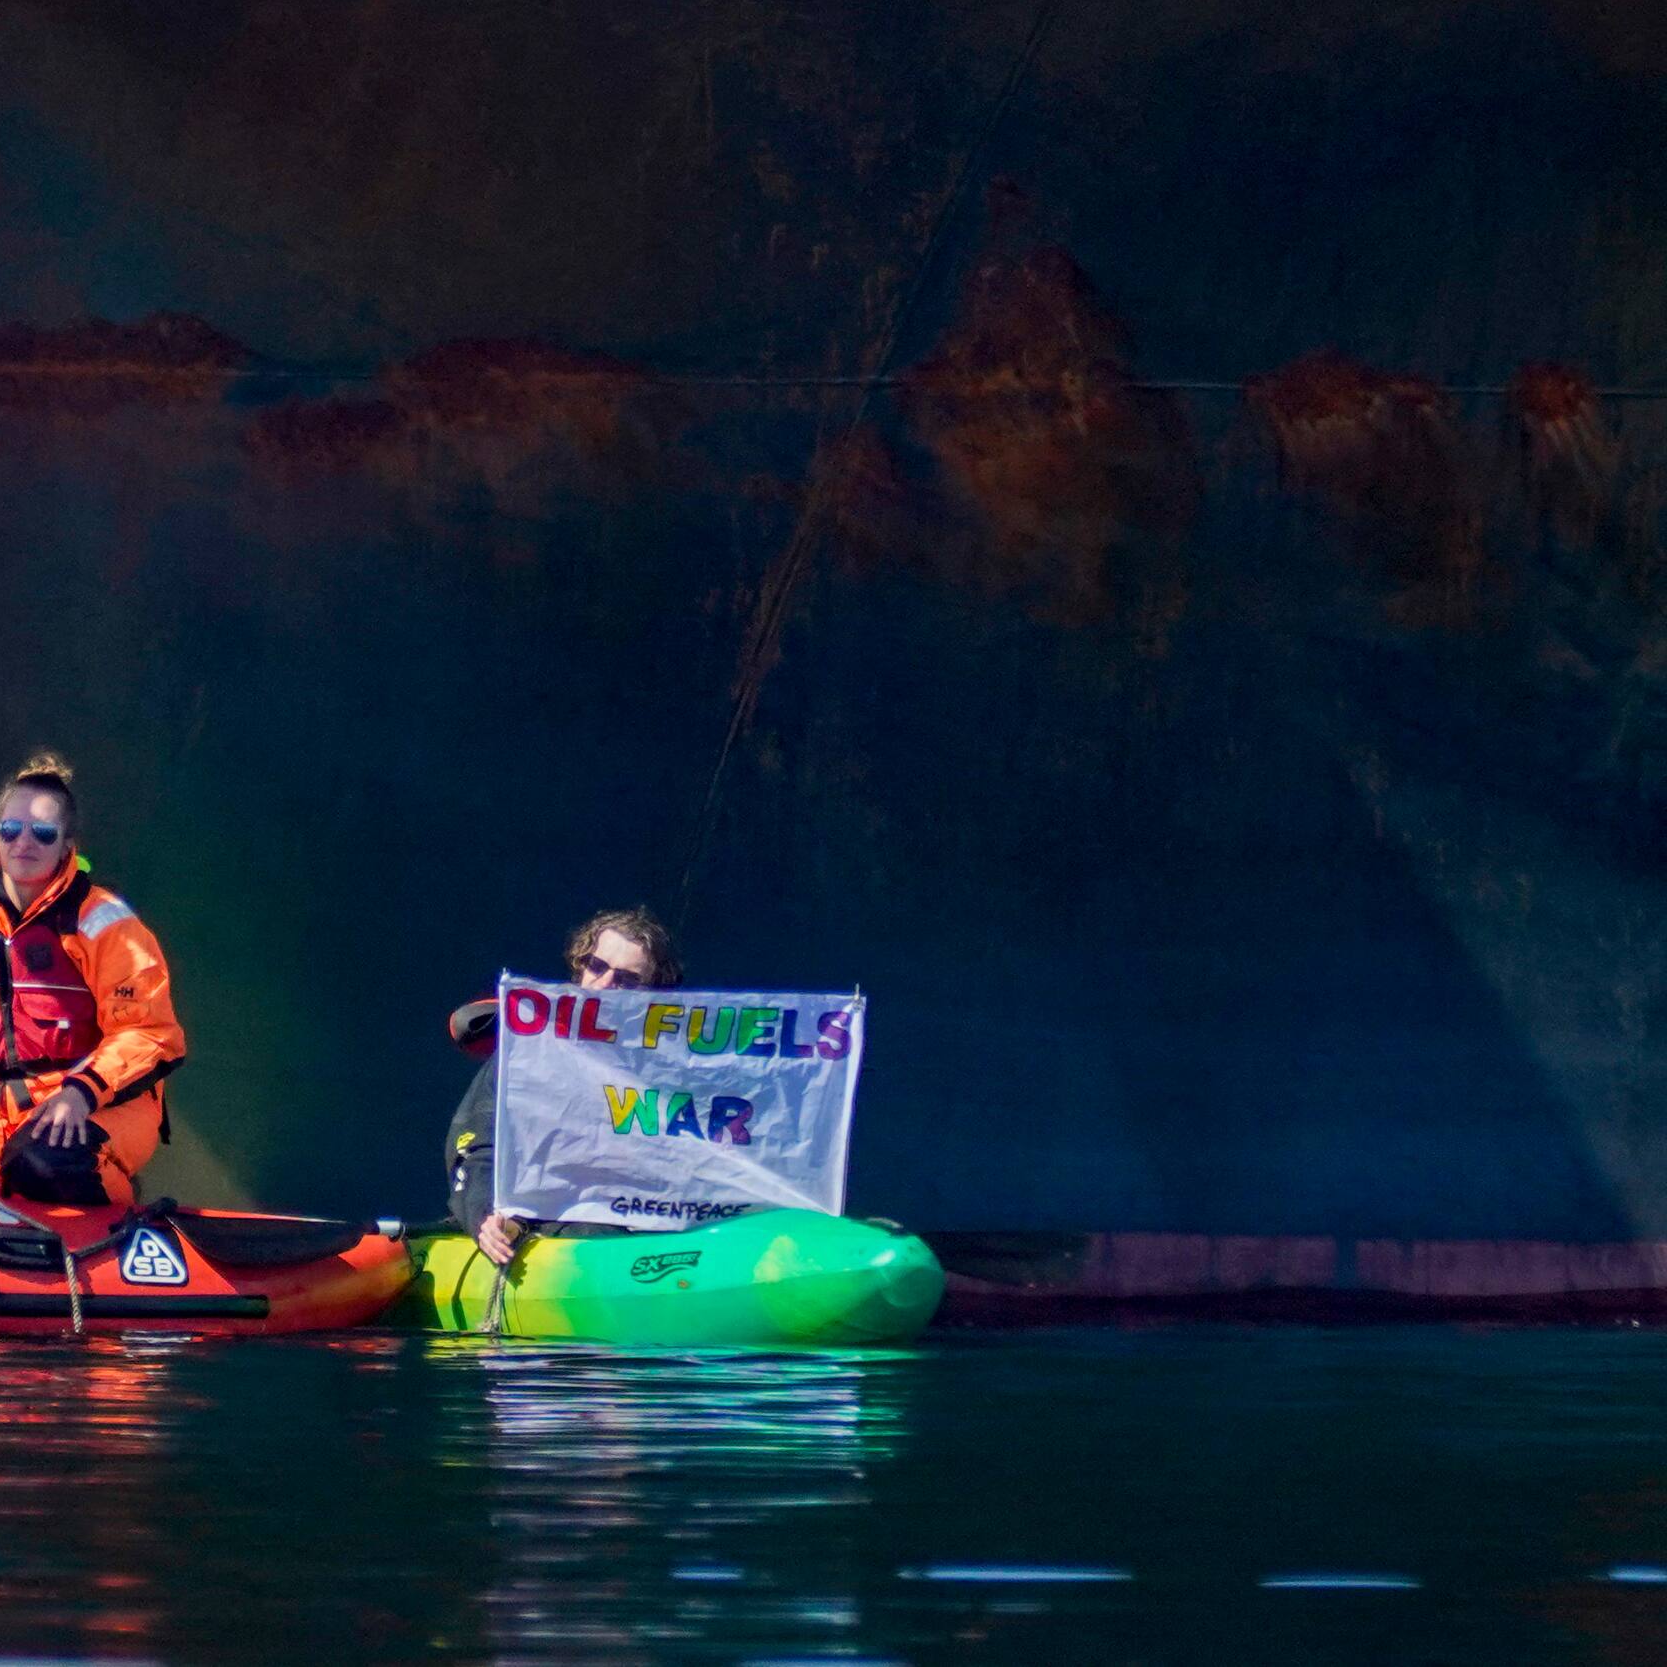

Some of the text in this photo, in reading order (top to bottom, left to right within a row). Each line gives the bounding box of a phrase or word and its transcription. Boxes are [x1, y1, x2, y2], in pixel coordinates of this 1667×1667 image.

[114, 987, 134, 999] HH
[505, 987, 853, 1062] OIL FUELS
[603, 1084, 754, 1145] WAR
[610, 1196, 753, 1219] GREENPEACE
